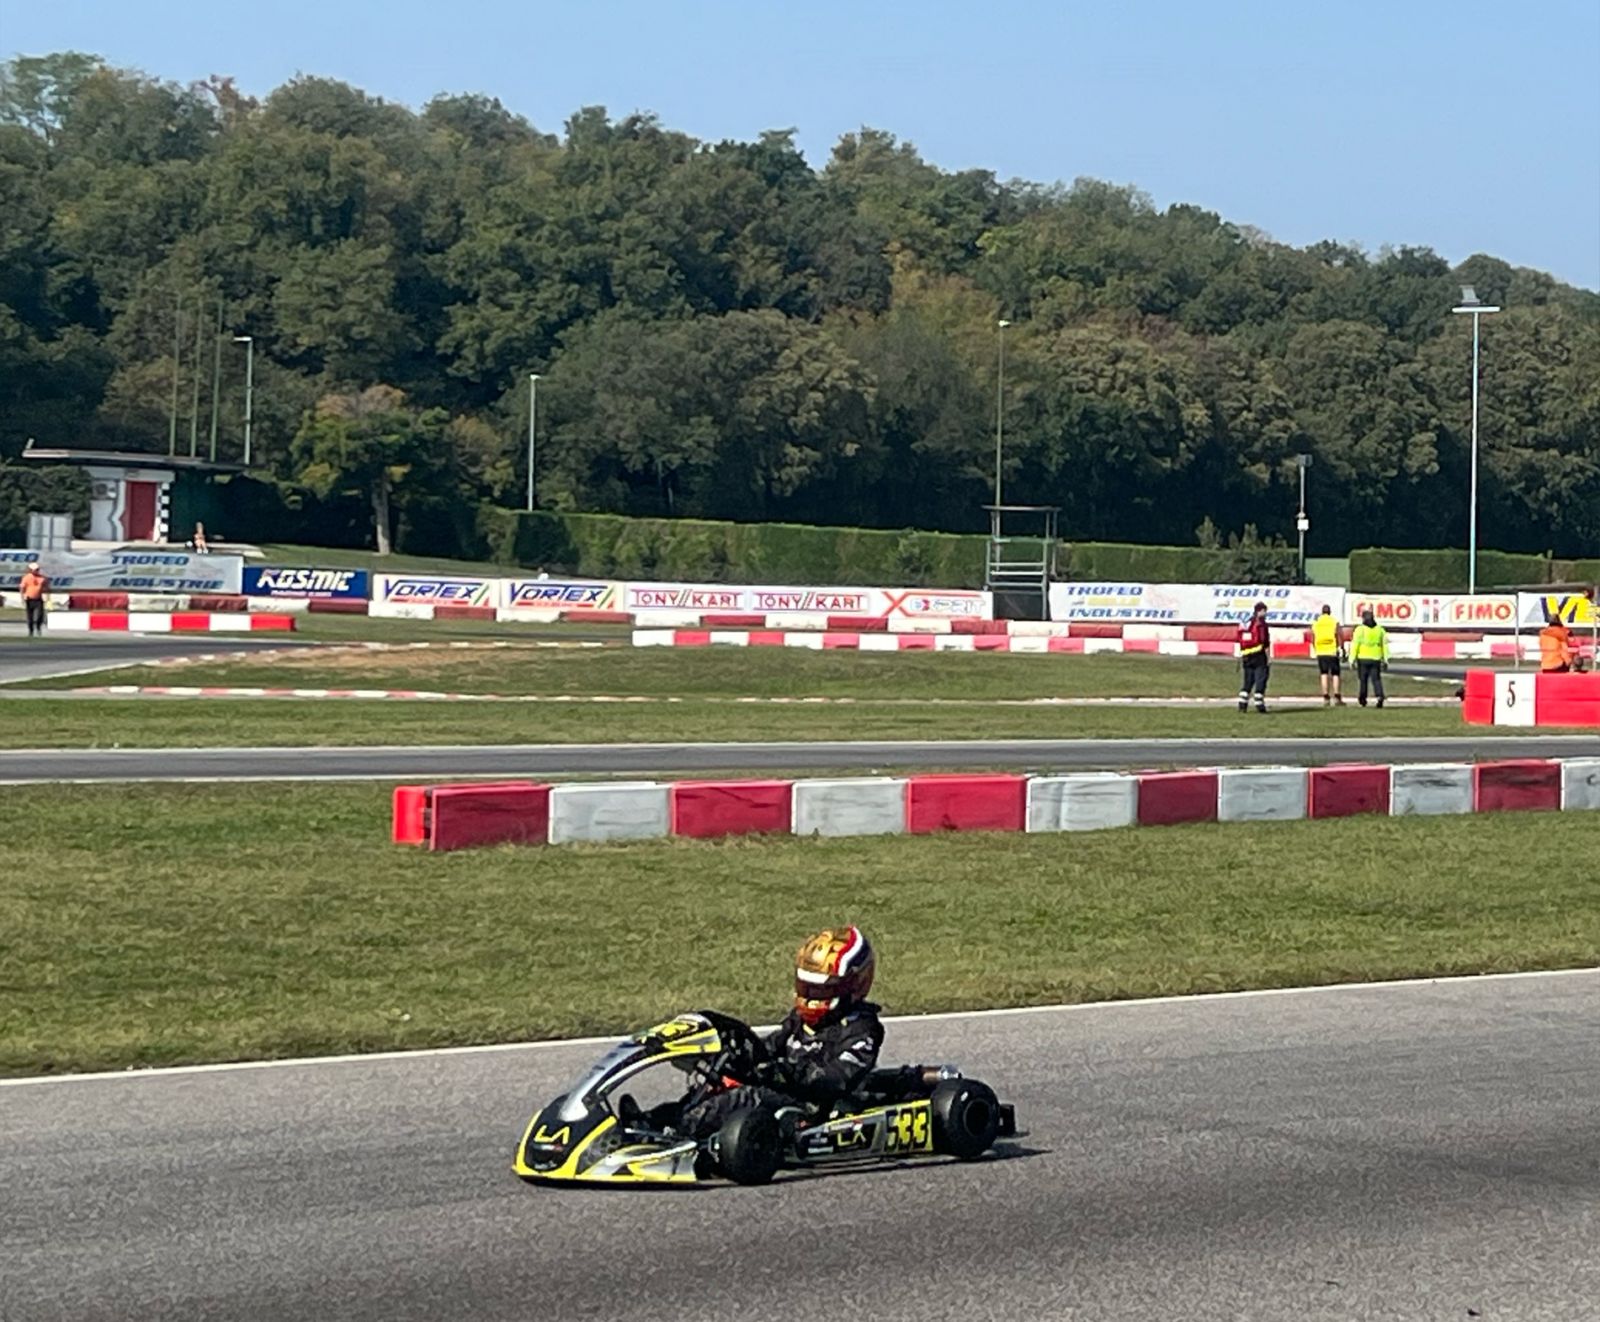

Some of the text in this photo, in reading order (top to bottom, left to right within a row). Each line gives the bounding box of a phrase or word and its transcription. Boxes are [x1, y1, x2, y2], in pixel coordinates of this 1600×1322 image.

[112, 555, 189, 566] TROFEO
[110, 577, 224, 590] INDUSTRIE
[256, 569, 355, 591] KOSMIC
[384, 579, 484, 600] VORTEX
[510, 583, 608, 604] VORTEX
[1067, 586, 1143, 596] TROFEO
[1213, 588, 1290, 598] TROFEO
[1069, 608, 1179, 618] INDUSTRIE
[1456, 603, 1511, 620] FIMO
[1507, 680, 1516, 708] 5
[885, 1106, 929, 1152] 533
